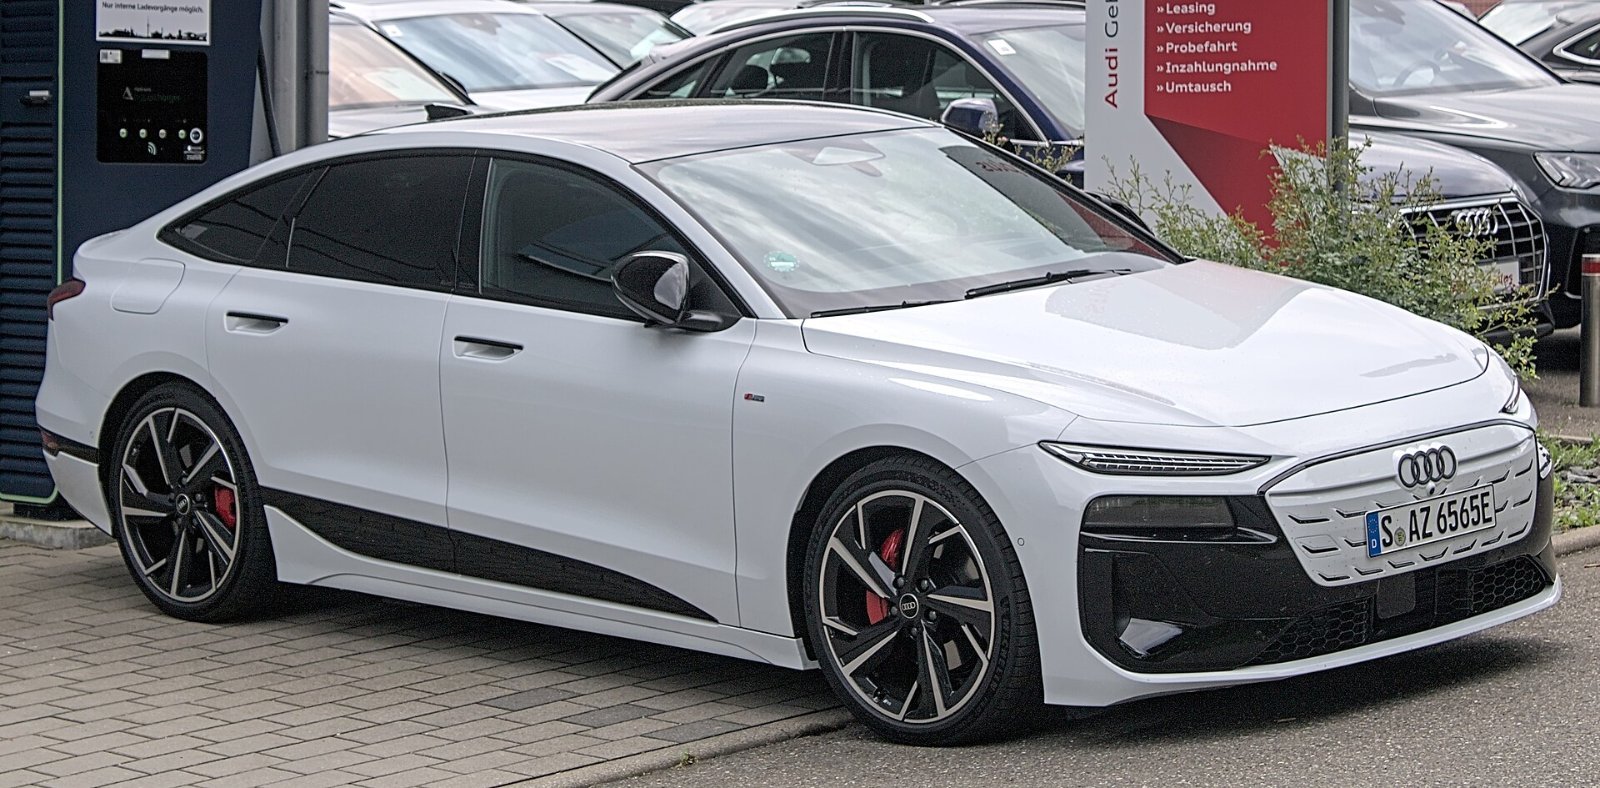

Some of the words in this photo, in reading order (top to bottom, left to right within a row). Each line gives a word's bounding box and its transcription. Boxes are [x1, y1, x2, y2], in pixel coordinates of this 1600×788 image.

[115, 2, 136, 10] interne
[137, 3, 178, 13] Ladevorgänge
[1166, 2, 1216, 16] Leasing
[1104, 0, 1118, 38] Ge
[1165, 20, 1252, 34] Versicherung
[1166, 41, 1238, 54] Probefahrt
[1166, 60, 1278, 75] Inzahlungnahme
[1104, 48, 1118, 109] Audi
[1166, 80, 1232, 93] Umtausch
[1371, 538, 1377, 549] D
[1381, 515, 1393, 548] S
[1409, 506, 1433, 543] AZ
[1437, 491, 1493, 535] 6565E
